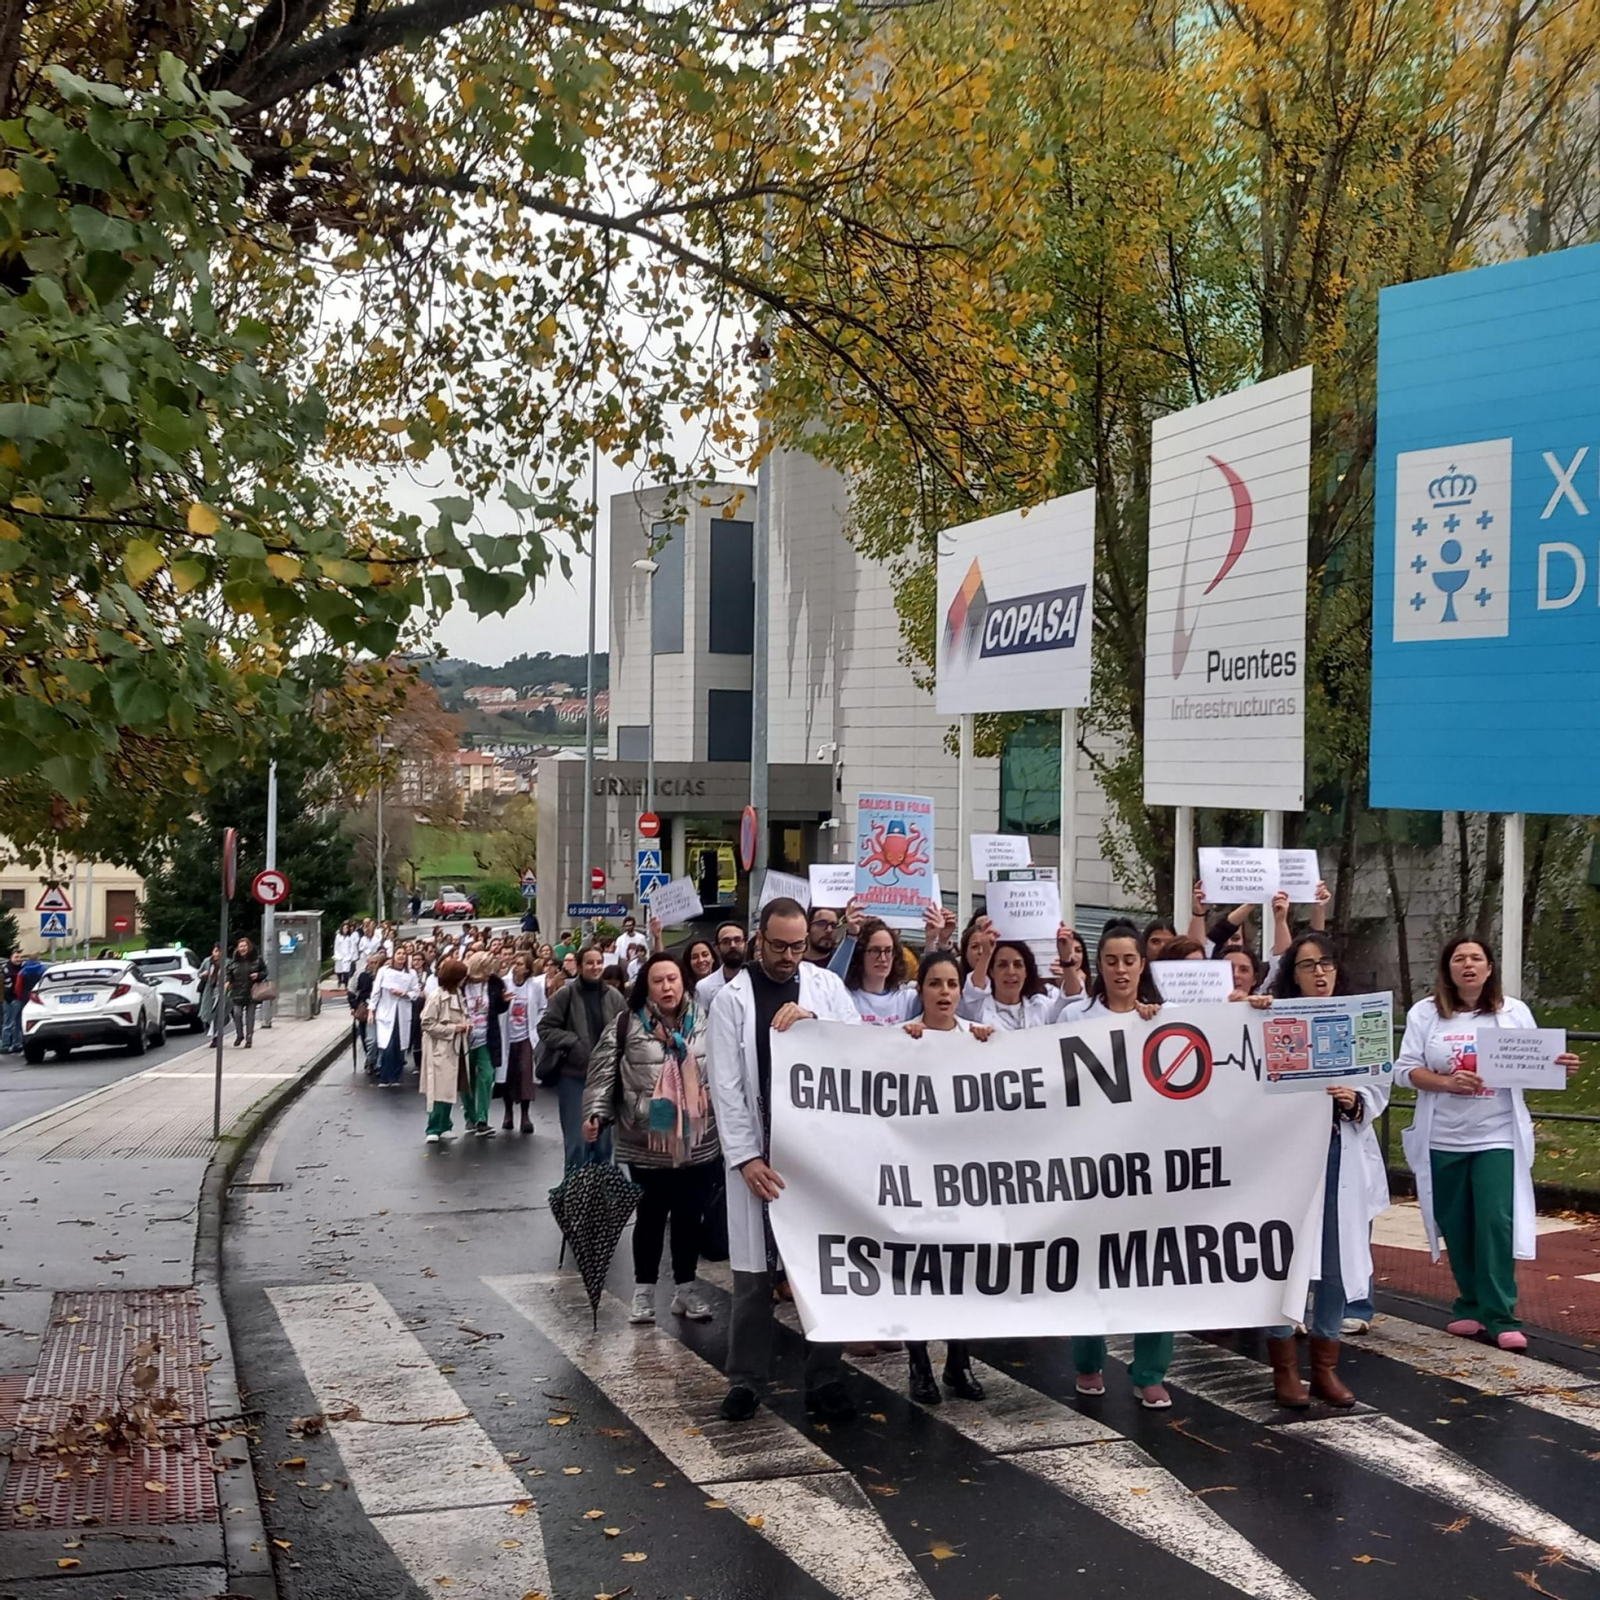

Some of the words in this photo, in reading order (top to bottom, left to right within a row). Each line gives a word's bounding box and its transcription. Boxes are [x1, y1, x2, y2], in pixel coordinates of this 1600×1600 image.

[1540, 445, 1600, 520] X
[1537, 541, 1600, 611] D
[985, 596, 1078, 650] COPASA
[1207, 649, 1297, 683] Puentes
[1171, 697, 1296, 720] Infraestructuras
[1004, 900, 1046, 909] ESTATUTO
[1009, 909, 1044, 918] MÉDICO
[789, 1063, 939, 1118] GALICIA
[952, 1067, 1047, 1113] DICE
[1059, 1022, 1213, 1108] NO
[878, 1163, 923, 1208] AL
[933, 1151, 1153, 1208] BORRADOR
[1164, 1145, 1232, 1193] DEL
[817, 1233, 1080, 1297] ESTATUTO
[1099, 1219, 1295, 1290] MARCO
